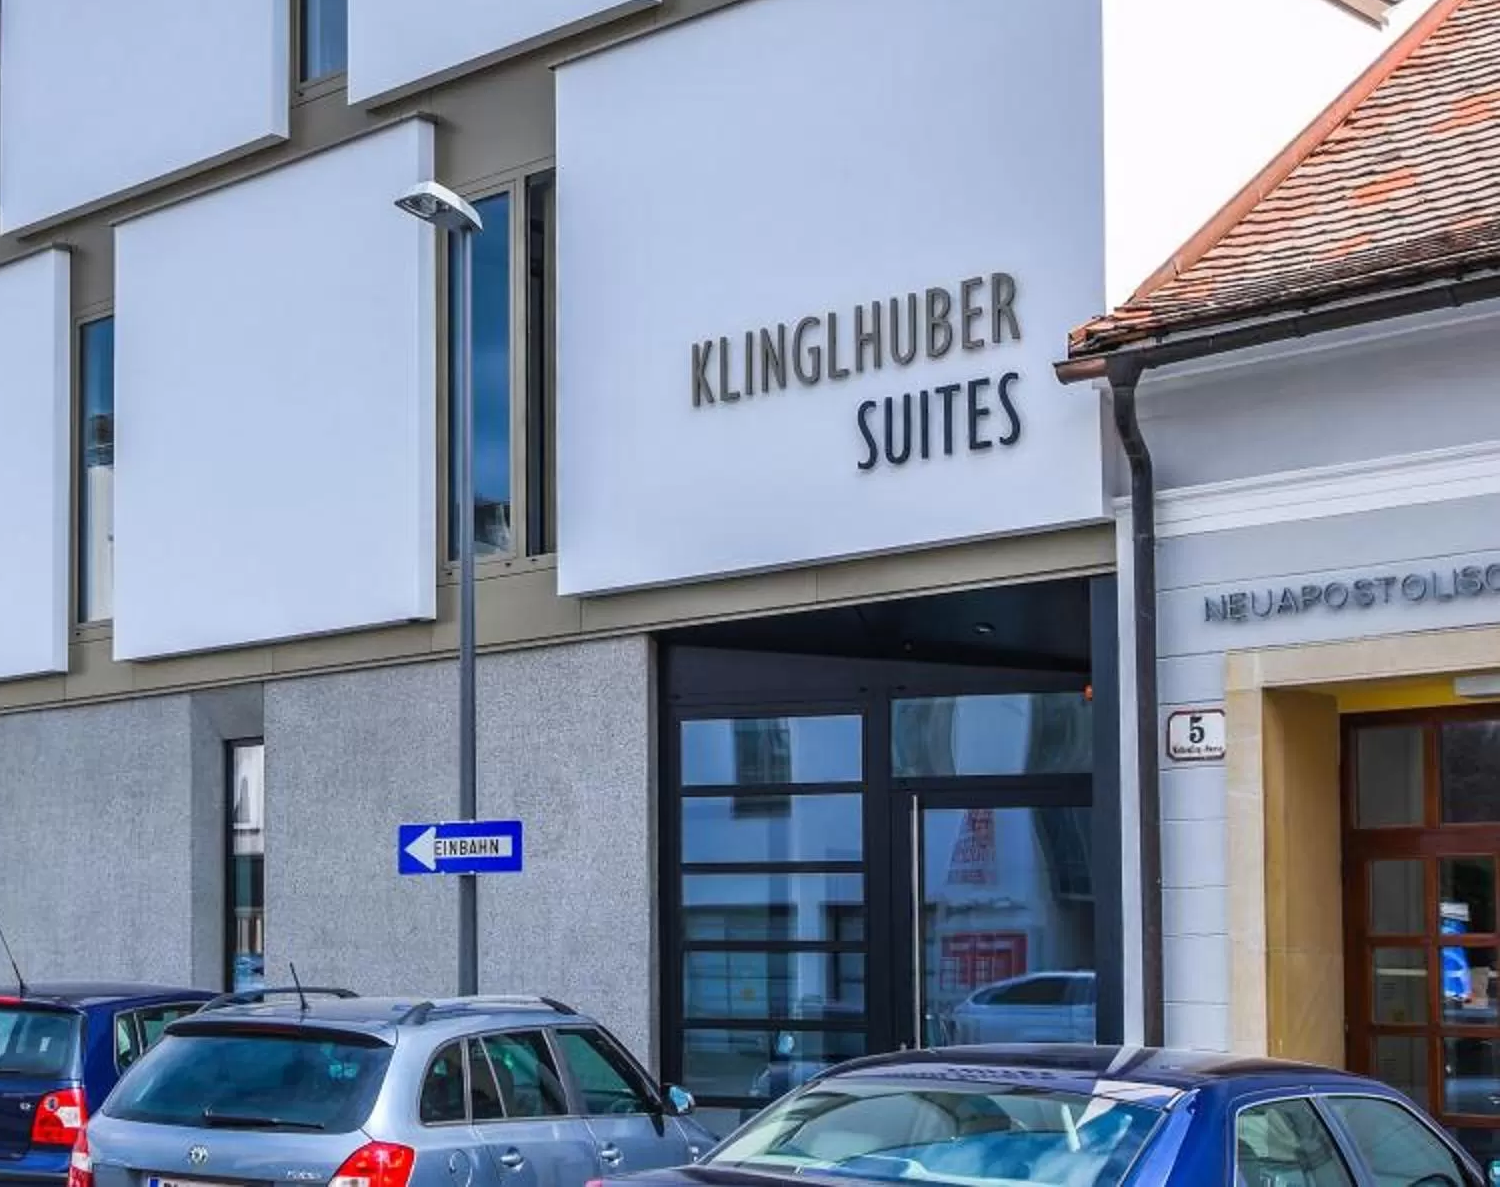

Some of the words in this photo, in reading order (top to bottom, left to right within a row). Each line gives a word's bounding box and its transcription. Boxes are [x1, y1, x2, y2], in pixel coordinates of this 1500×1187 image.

[691, 272, 1021, 408] KLINGLHUBER
[856, 372, 1021, 470] SUITES
[1189, 716, 1204, 743] 5
[434, 839, 499, 855] EINBAHN
